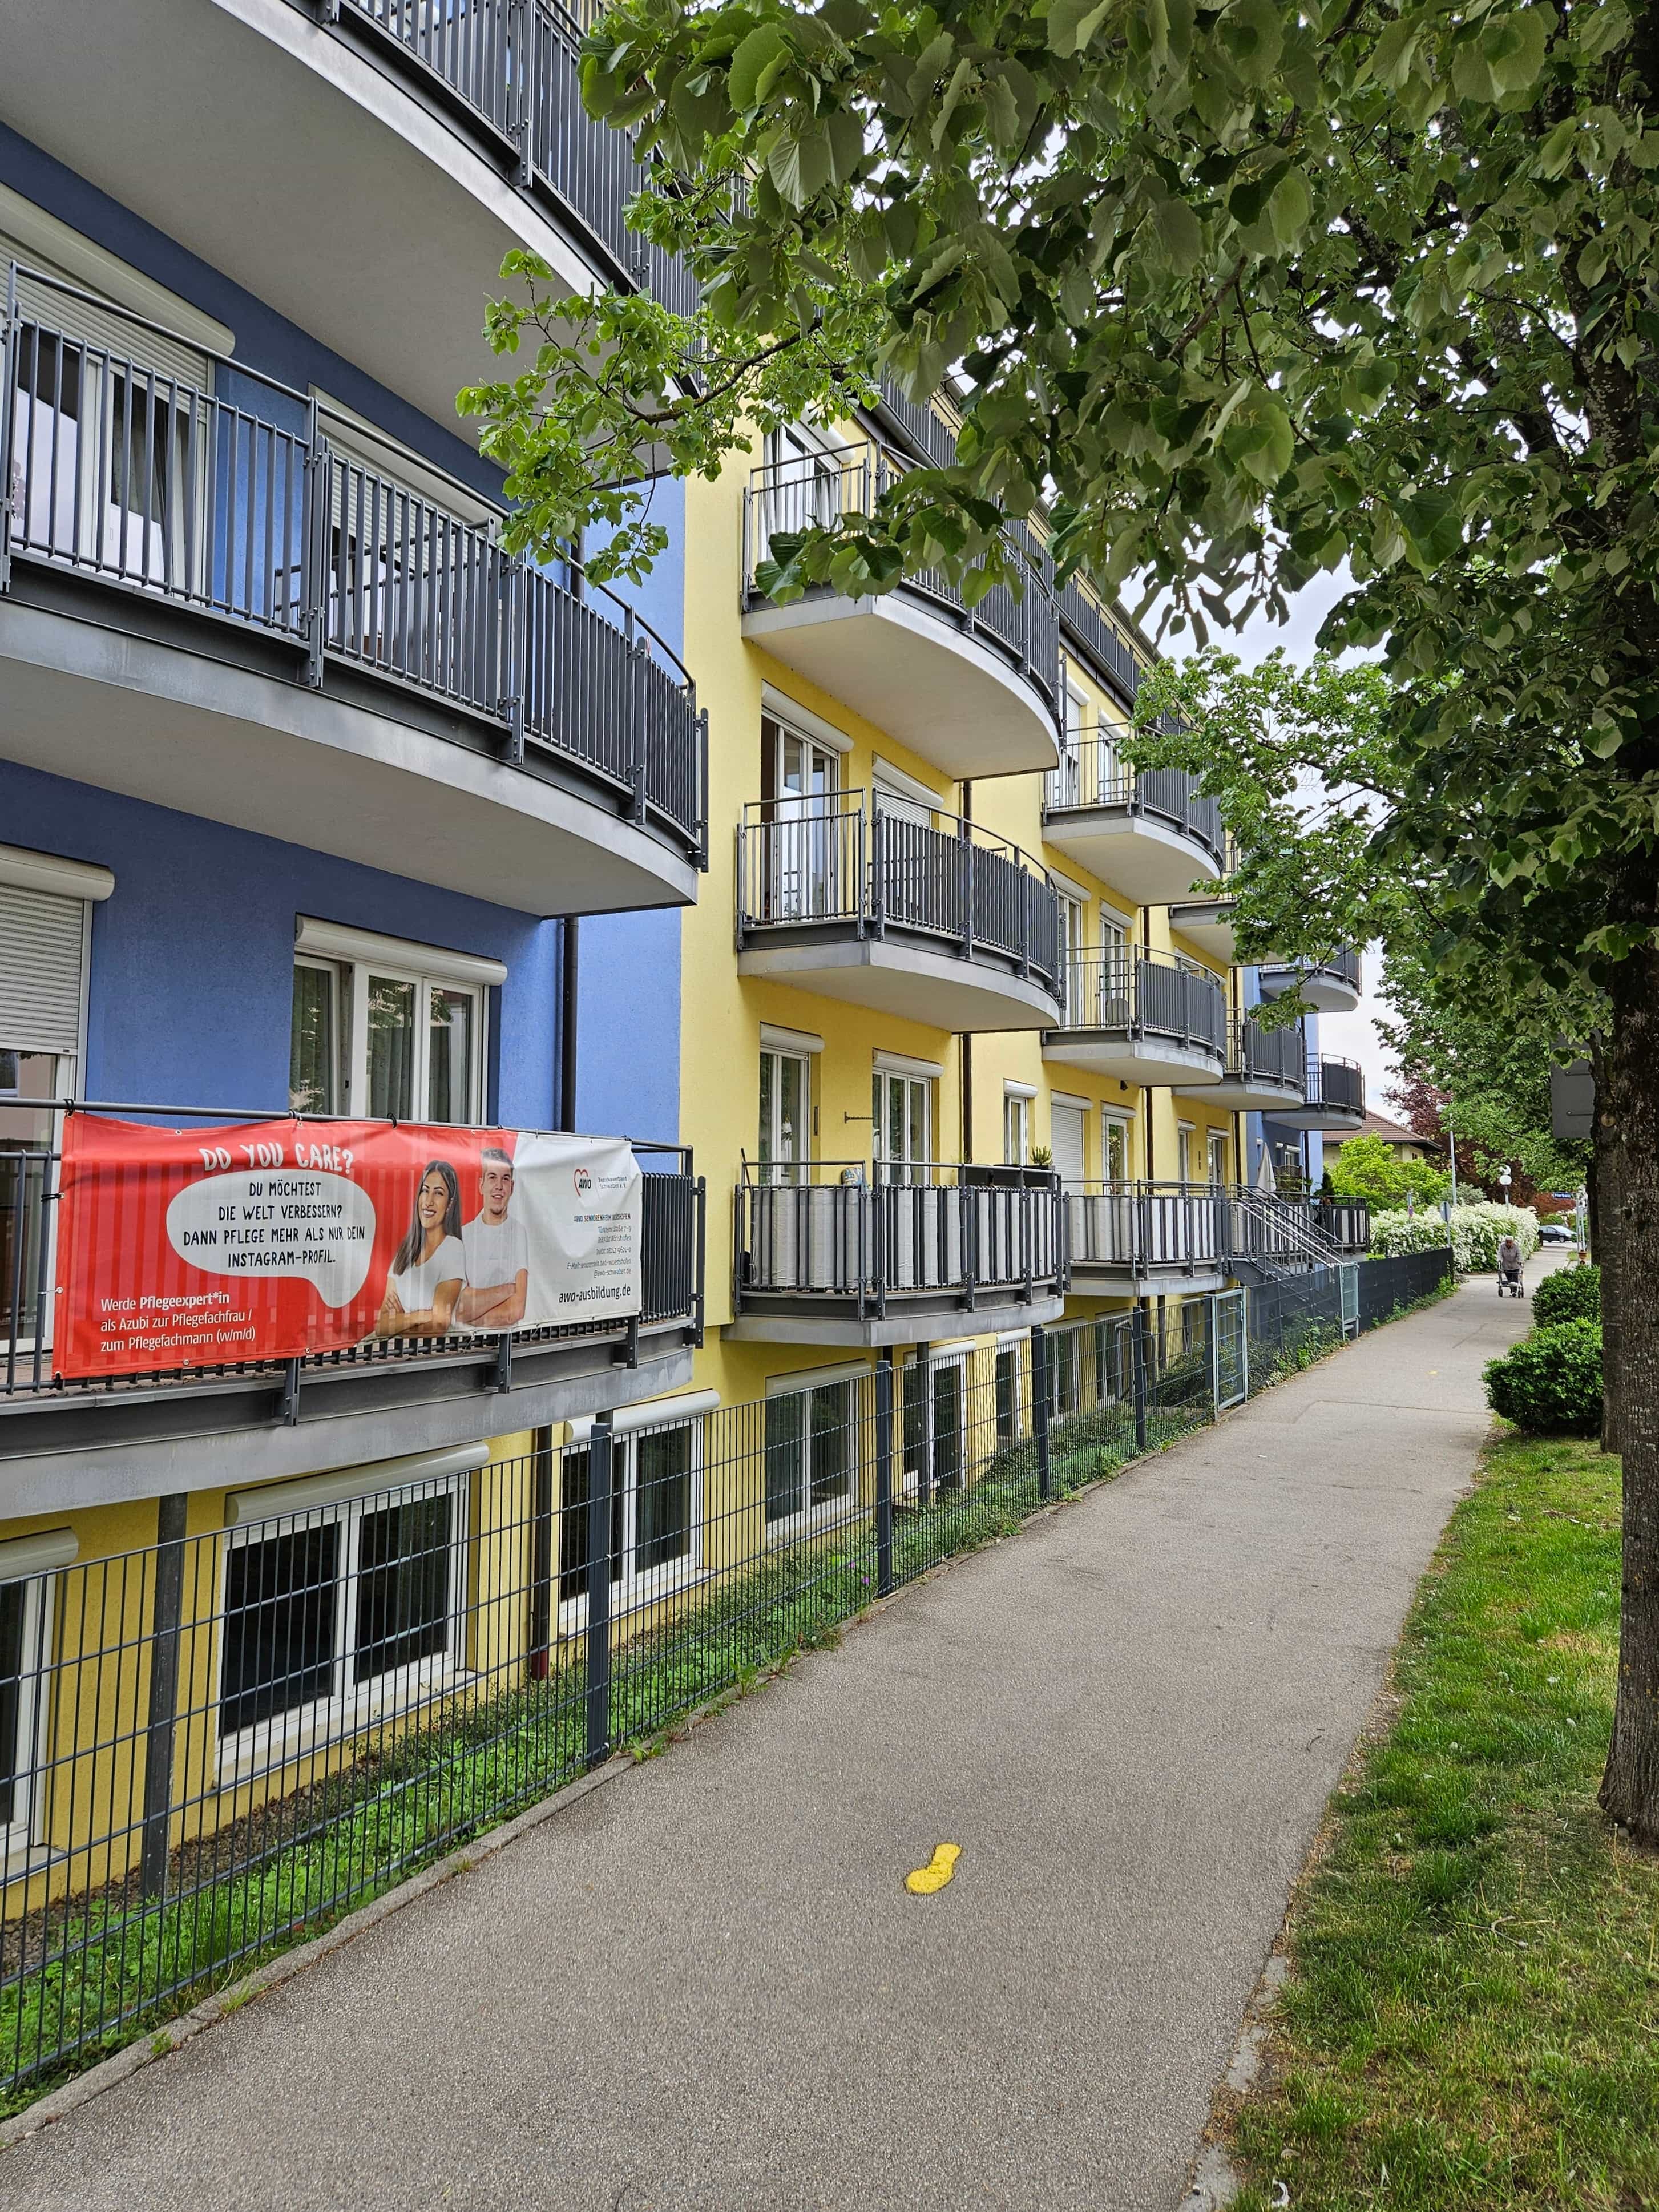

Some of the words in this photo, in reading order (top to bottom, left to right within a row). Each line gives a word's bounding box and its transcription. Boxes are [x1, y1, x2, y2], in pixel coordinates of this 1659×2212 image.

[199, 1147, 231, 1171] DO
[240, 1142, 284, 1168] YOU
[294, 1143, 354, 1174] CARE?
[249, 1182, 263, 1197] DU
[269, 1179, 322, 1197] MÖCHTEST
[579, 1178, 591, 1189] AWO
[219, 1205, 236, 1221] DIE
[243, 1205, 275, 1220] WELT
[281, 1204, 342, 1219] VERBESSERN?
[184, 1230, 217, 1246] DANN
[224, 1229, 264, 1244] PFLEGE
[271, 1228, 298, 1242] MEHR
[305, 1227, 324, 1241] ALS
[329, 1226, 343, 1240] NUR
[347, 1226, 365, 1240] DEIN
[228, 1249, 336, 1268] INSTAGRAM-PROFIL.
[559, 1283, 631, 1303] awo-ausbildung.de
[100, 1298, 136, 1311] Werde
[100, 1319, 116, 1332] als
[119, 1315, 148, 1330] Azubi
[152, 1317, 169, 1328] zur
[172, 1310, 245, 1328] Pflegefachfrau
[100, 1340, 124, 1352] zum
[128, 1333, 213, 1351] Pflegefachmann
[217, 1326, 256, 1344] (w/m/d)
